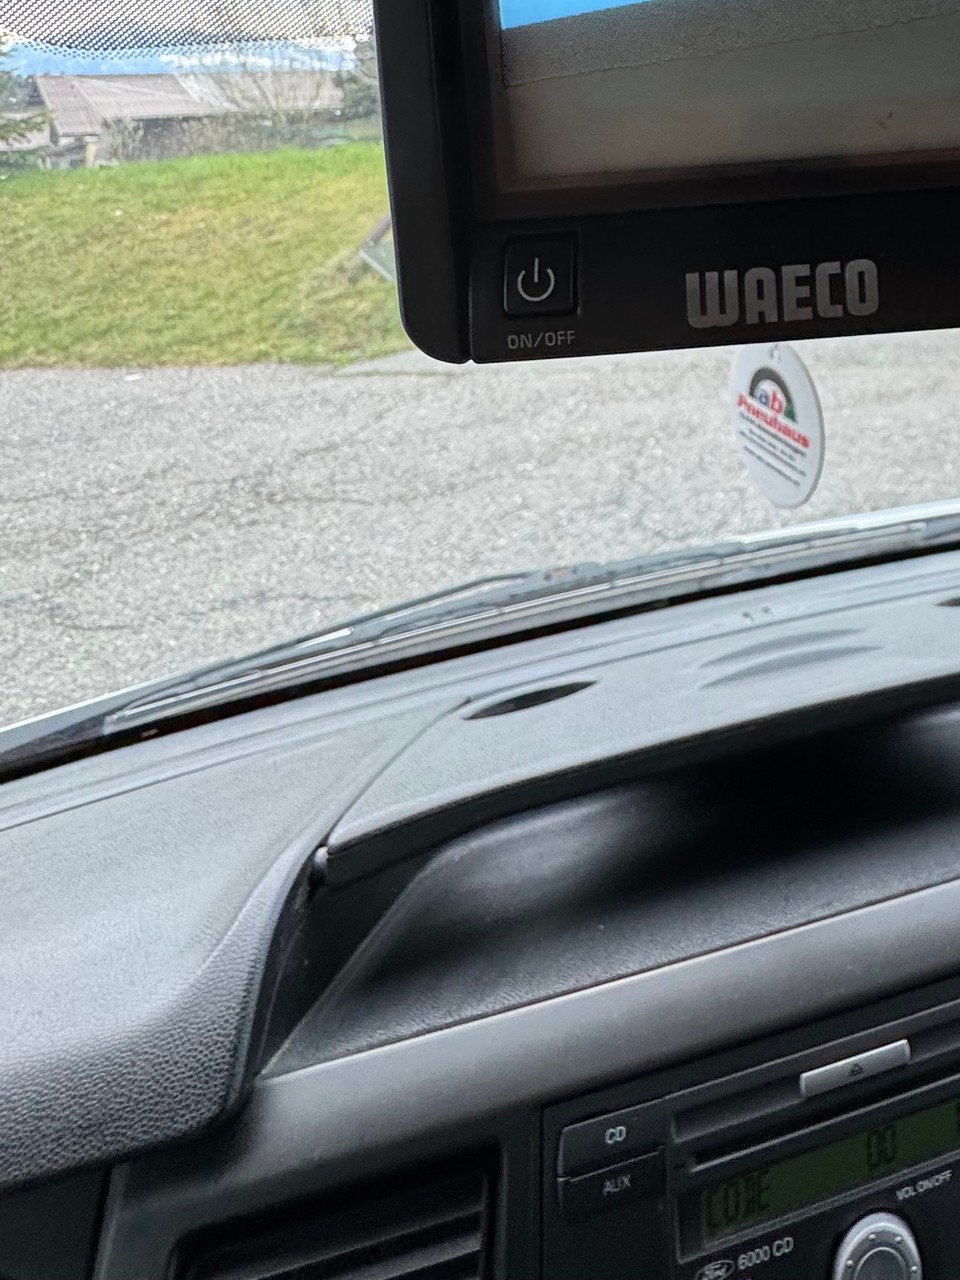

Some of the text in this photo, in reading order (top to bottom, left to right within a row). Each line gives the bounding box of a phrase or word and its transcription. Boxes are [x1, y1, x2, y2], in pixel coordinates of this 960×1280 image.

[686, 259, 880, 329] WAECO
[508, 330, 576, 349] ON/OFF
[605, 1126, 626, 1144] CD
[738, 1245, 771, 1270] 6000
[772, 1237, 794, 1257] CD
